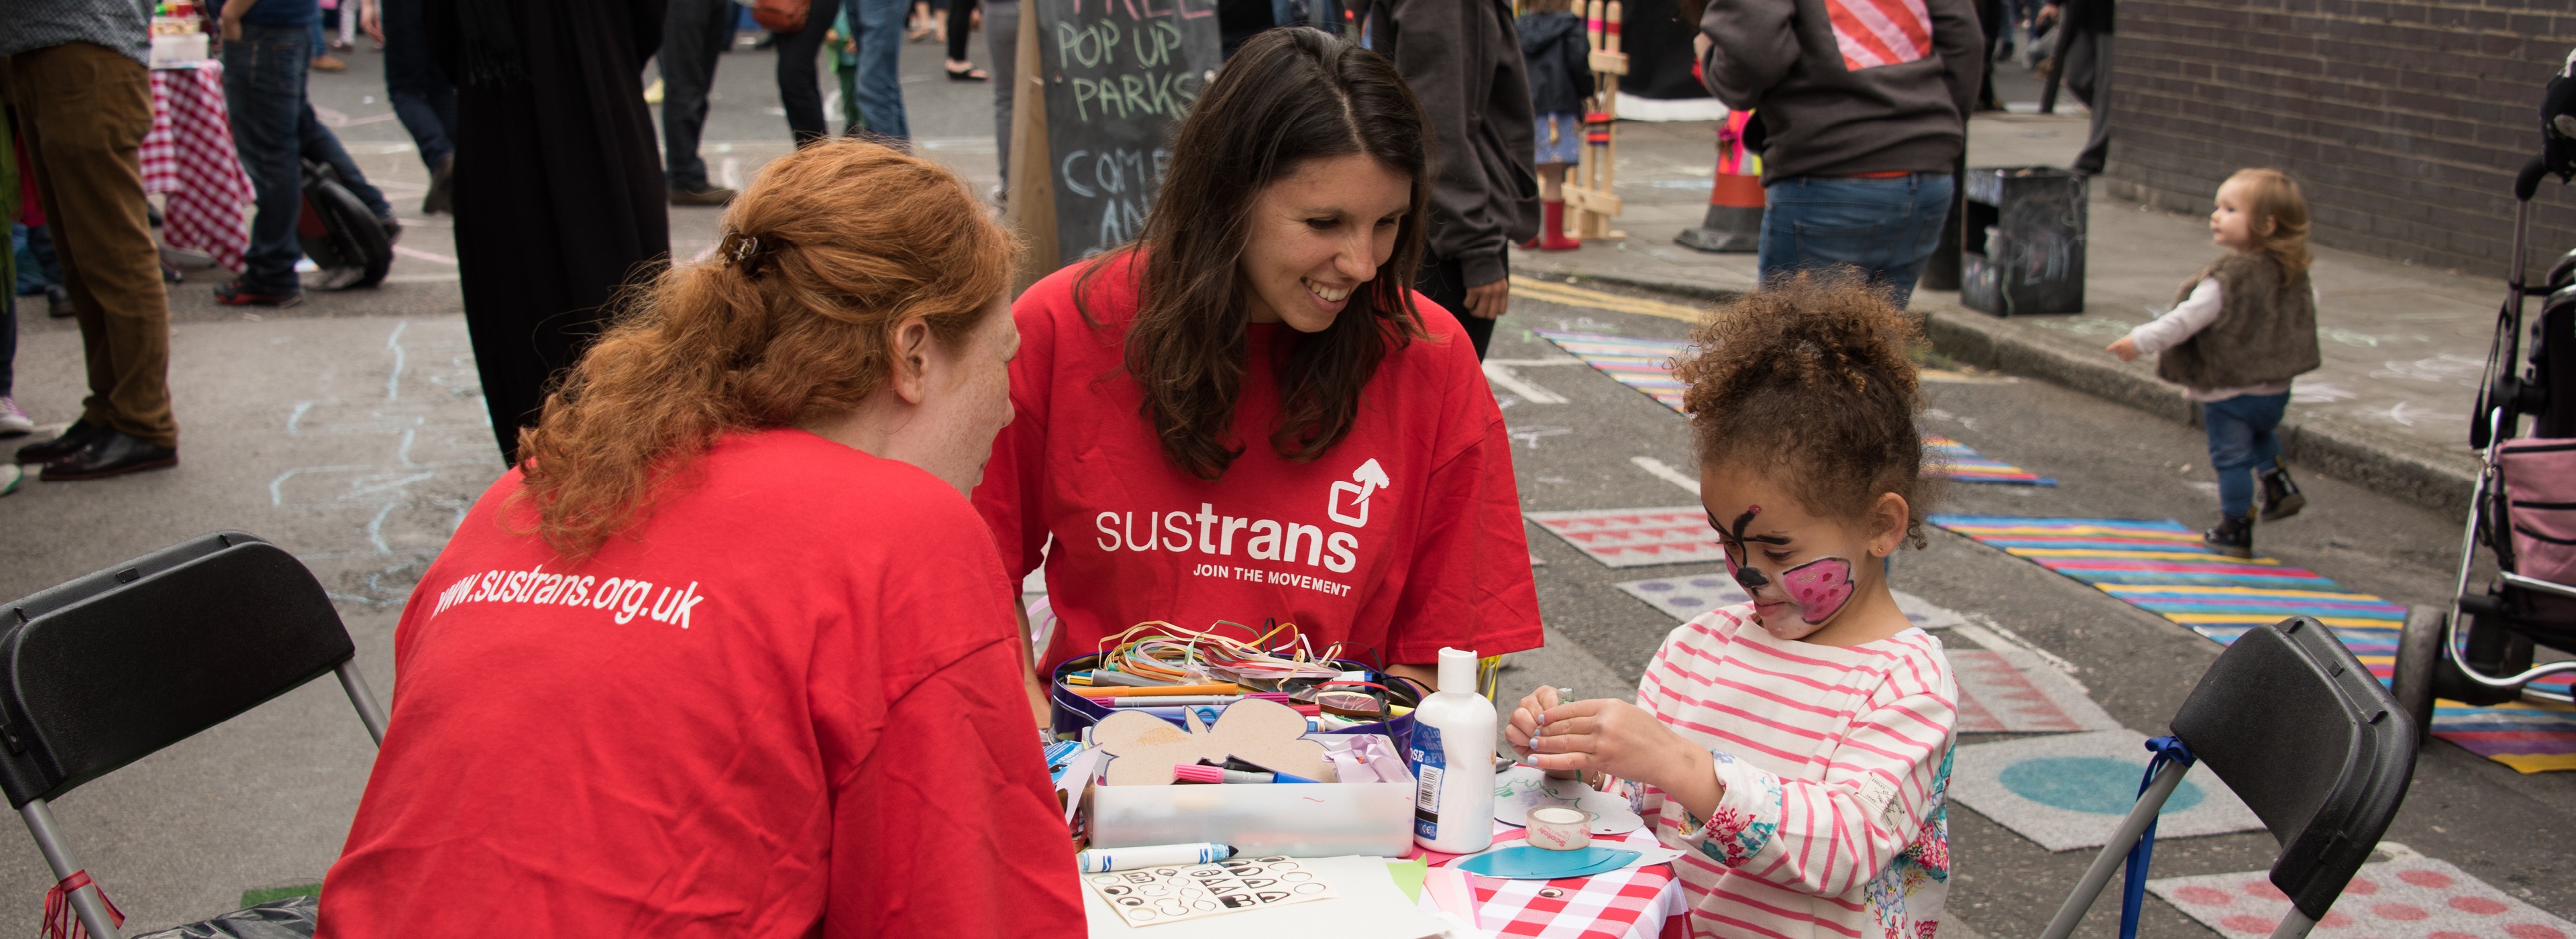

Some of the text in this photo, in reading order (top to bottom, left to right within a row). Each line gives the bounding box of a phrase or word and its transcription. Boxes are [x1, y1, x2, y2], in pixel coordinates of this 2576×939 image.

[1057, 17, 1181, 70] POP UP
[1072, 71, 1198, 121] PARKS
[1062, 147, 1173, 198] COME
[1096, 502, 1358, 573] sustrans
[430, 564, 704, 629] www.sustrans.org.uk
[1193, 563, 1351, 597] JOIN THE MOVEMENT
[1872, 779, 1885, 789] JOULES
